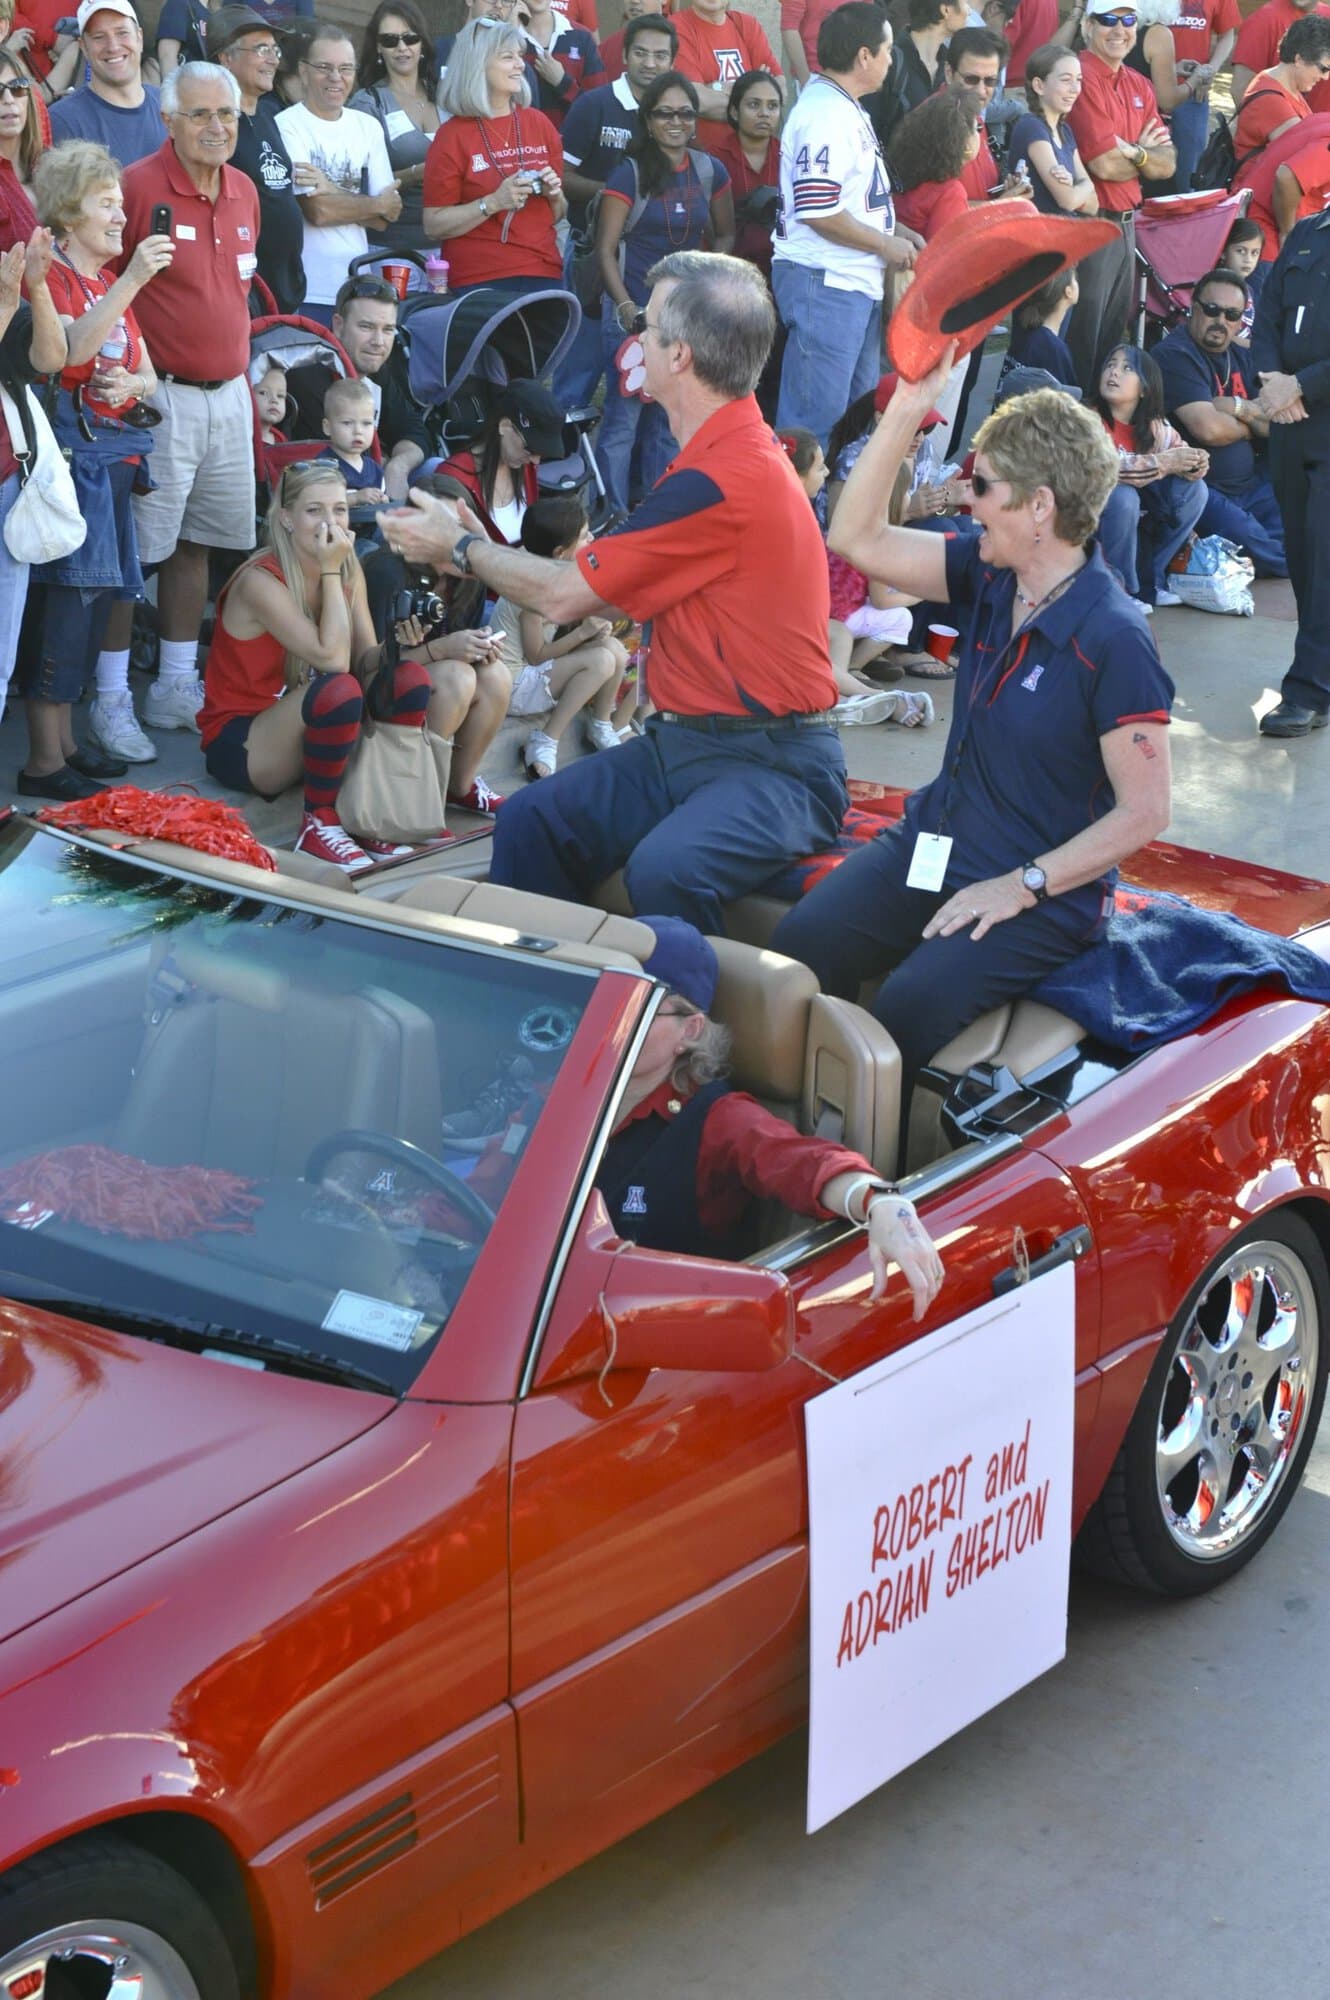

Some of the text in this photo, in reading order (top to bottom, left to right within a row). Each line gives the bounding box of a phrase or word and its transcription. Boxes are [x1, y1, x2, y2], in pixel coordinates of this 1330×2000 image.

[795, 144, 830, 174] 44
[622, 1185, 647, 1213] A
[871, 1418, 1031, 1574] ROBERT and
[836, 1479, 1050, 1669] ADRIAN SHELTON
